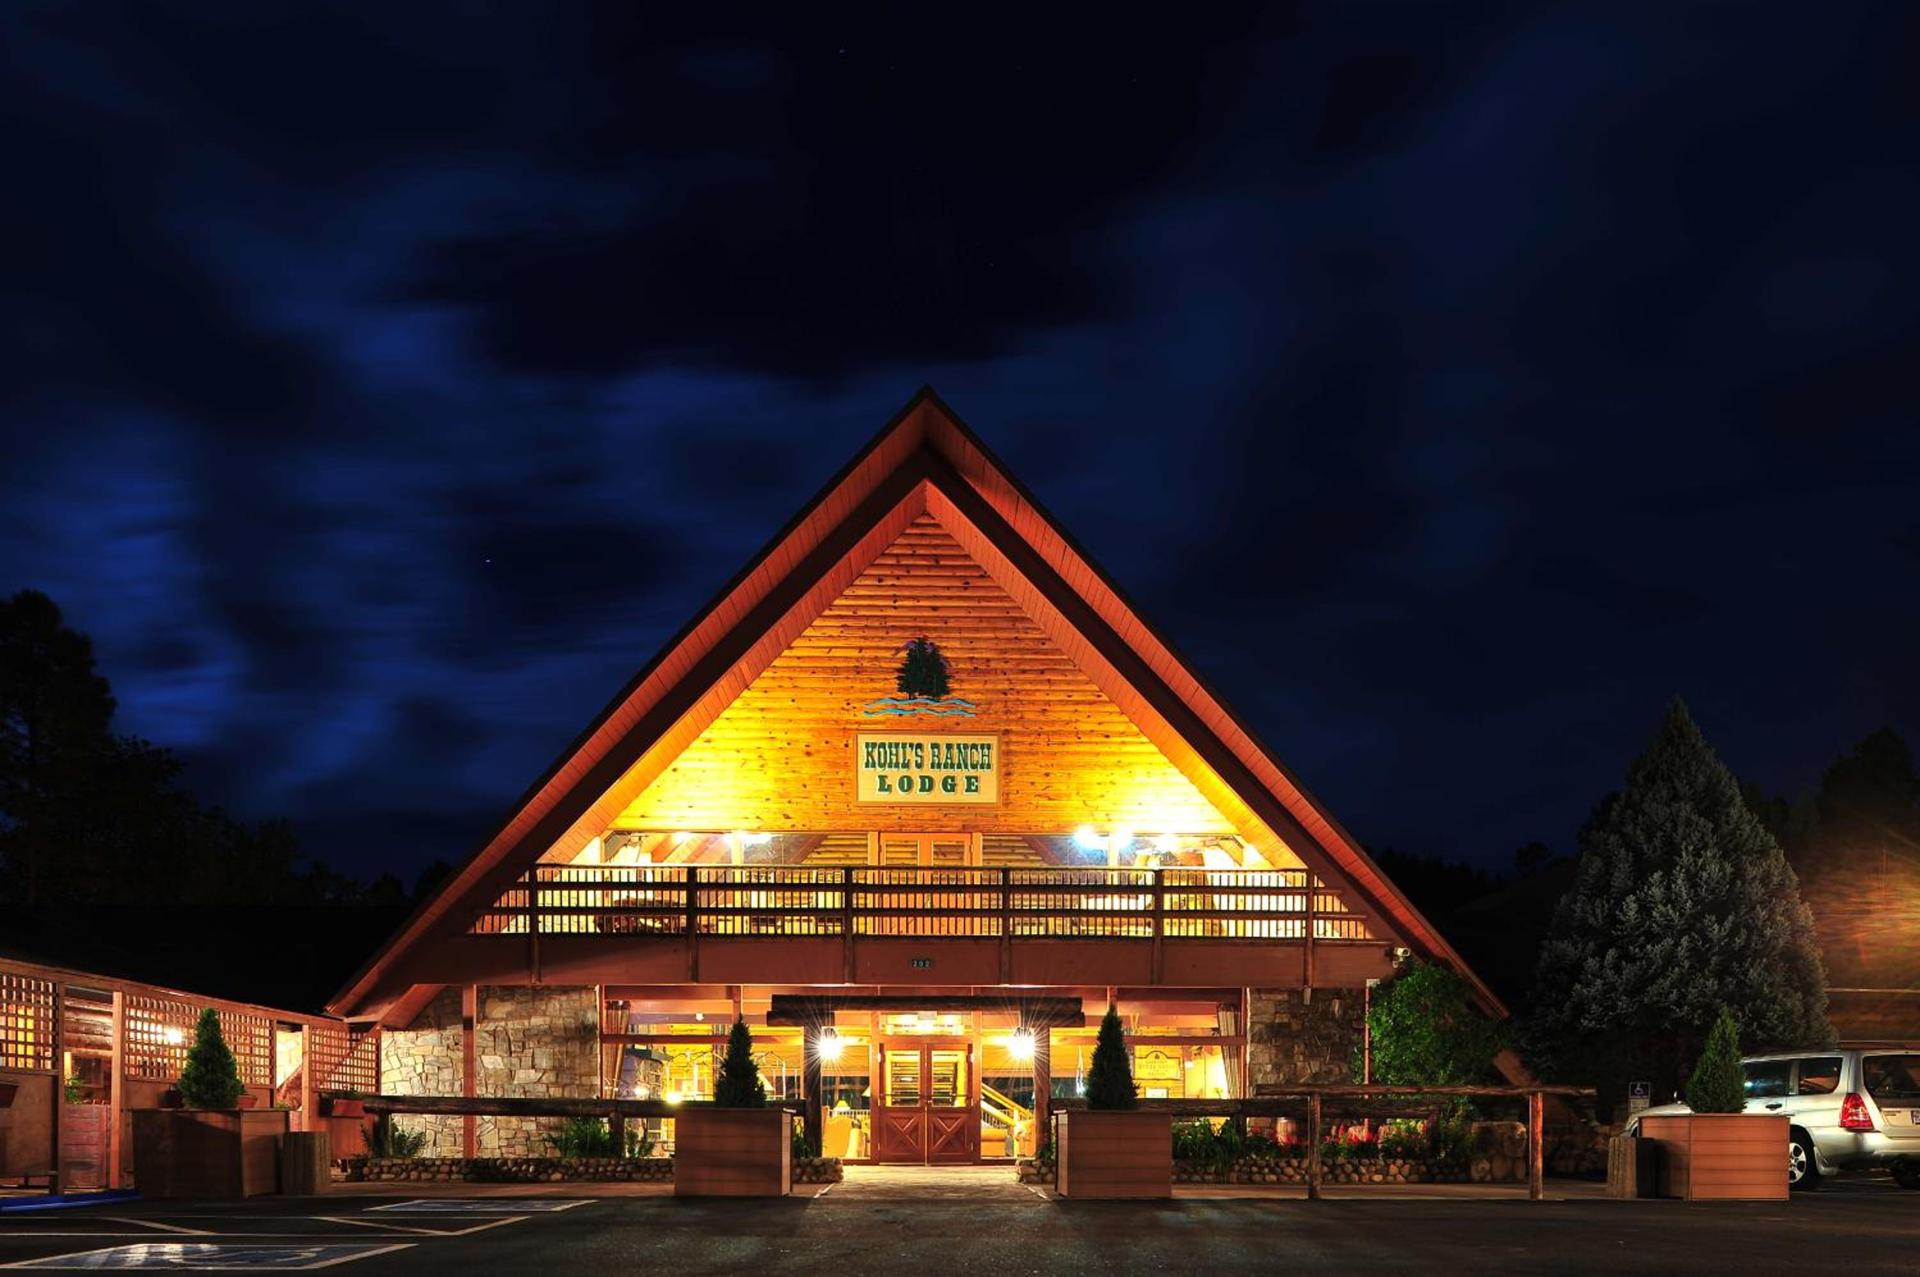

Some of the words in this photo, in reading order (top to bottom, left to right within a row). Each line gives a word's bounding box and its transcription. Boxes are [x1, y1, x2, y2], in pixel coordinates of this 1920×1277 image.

[864, 742, 924, 769] KOHL'S
[930, 742, 992, 770] RANCH
[878, 775, 979, 793] LODGE
